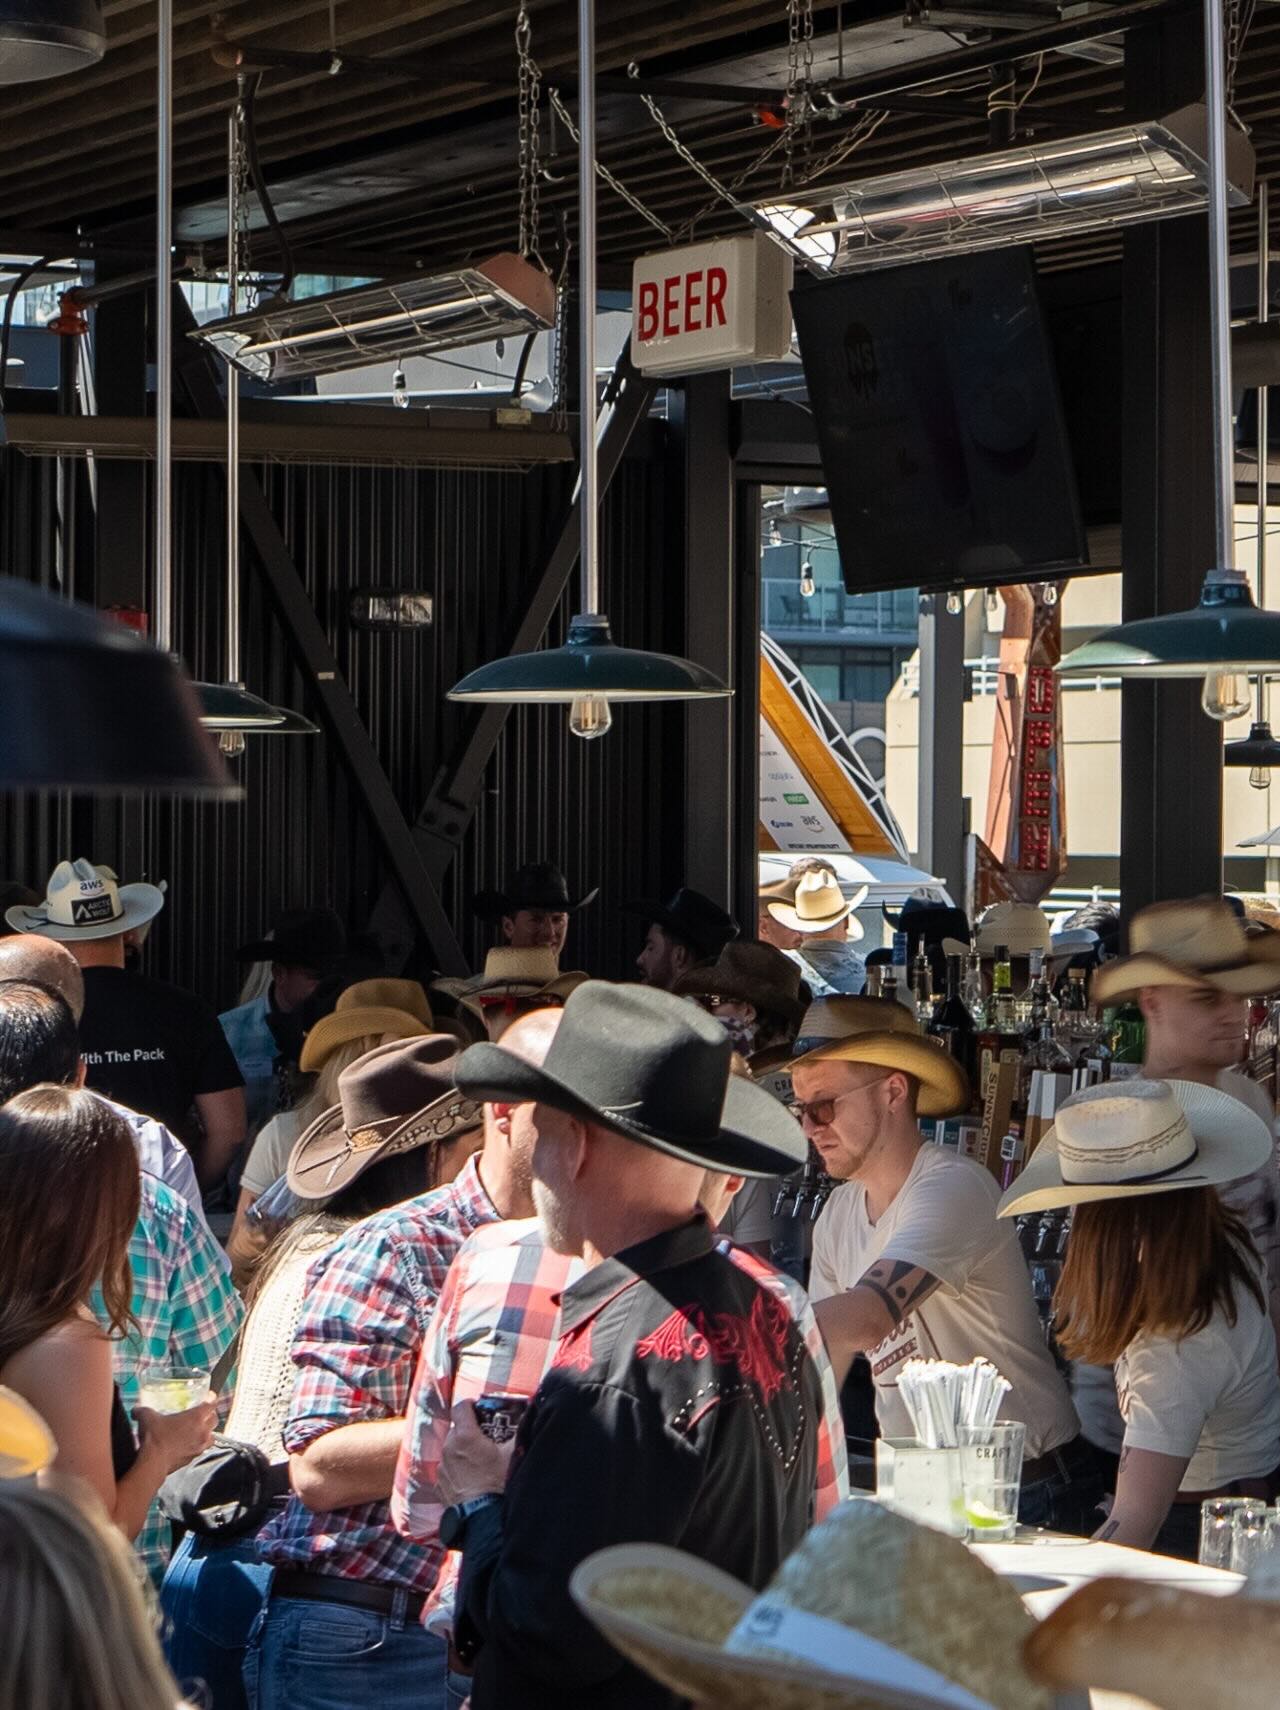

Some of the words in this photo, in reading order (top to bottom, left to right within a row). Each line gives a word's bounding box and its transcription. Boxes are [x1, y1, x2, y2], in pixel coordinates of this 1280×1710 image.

[638, 267, 727, 342] BEER
[80, 880, 104, 891] aws
[105, 1050, 131, 1064] The
[133, 1048, 165, 1062] Pack
